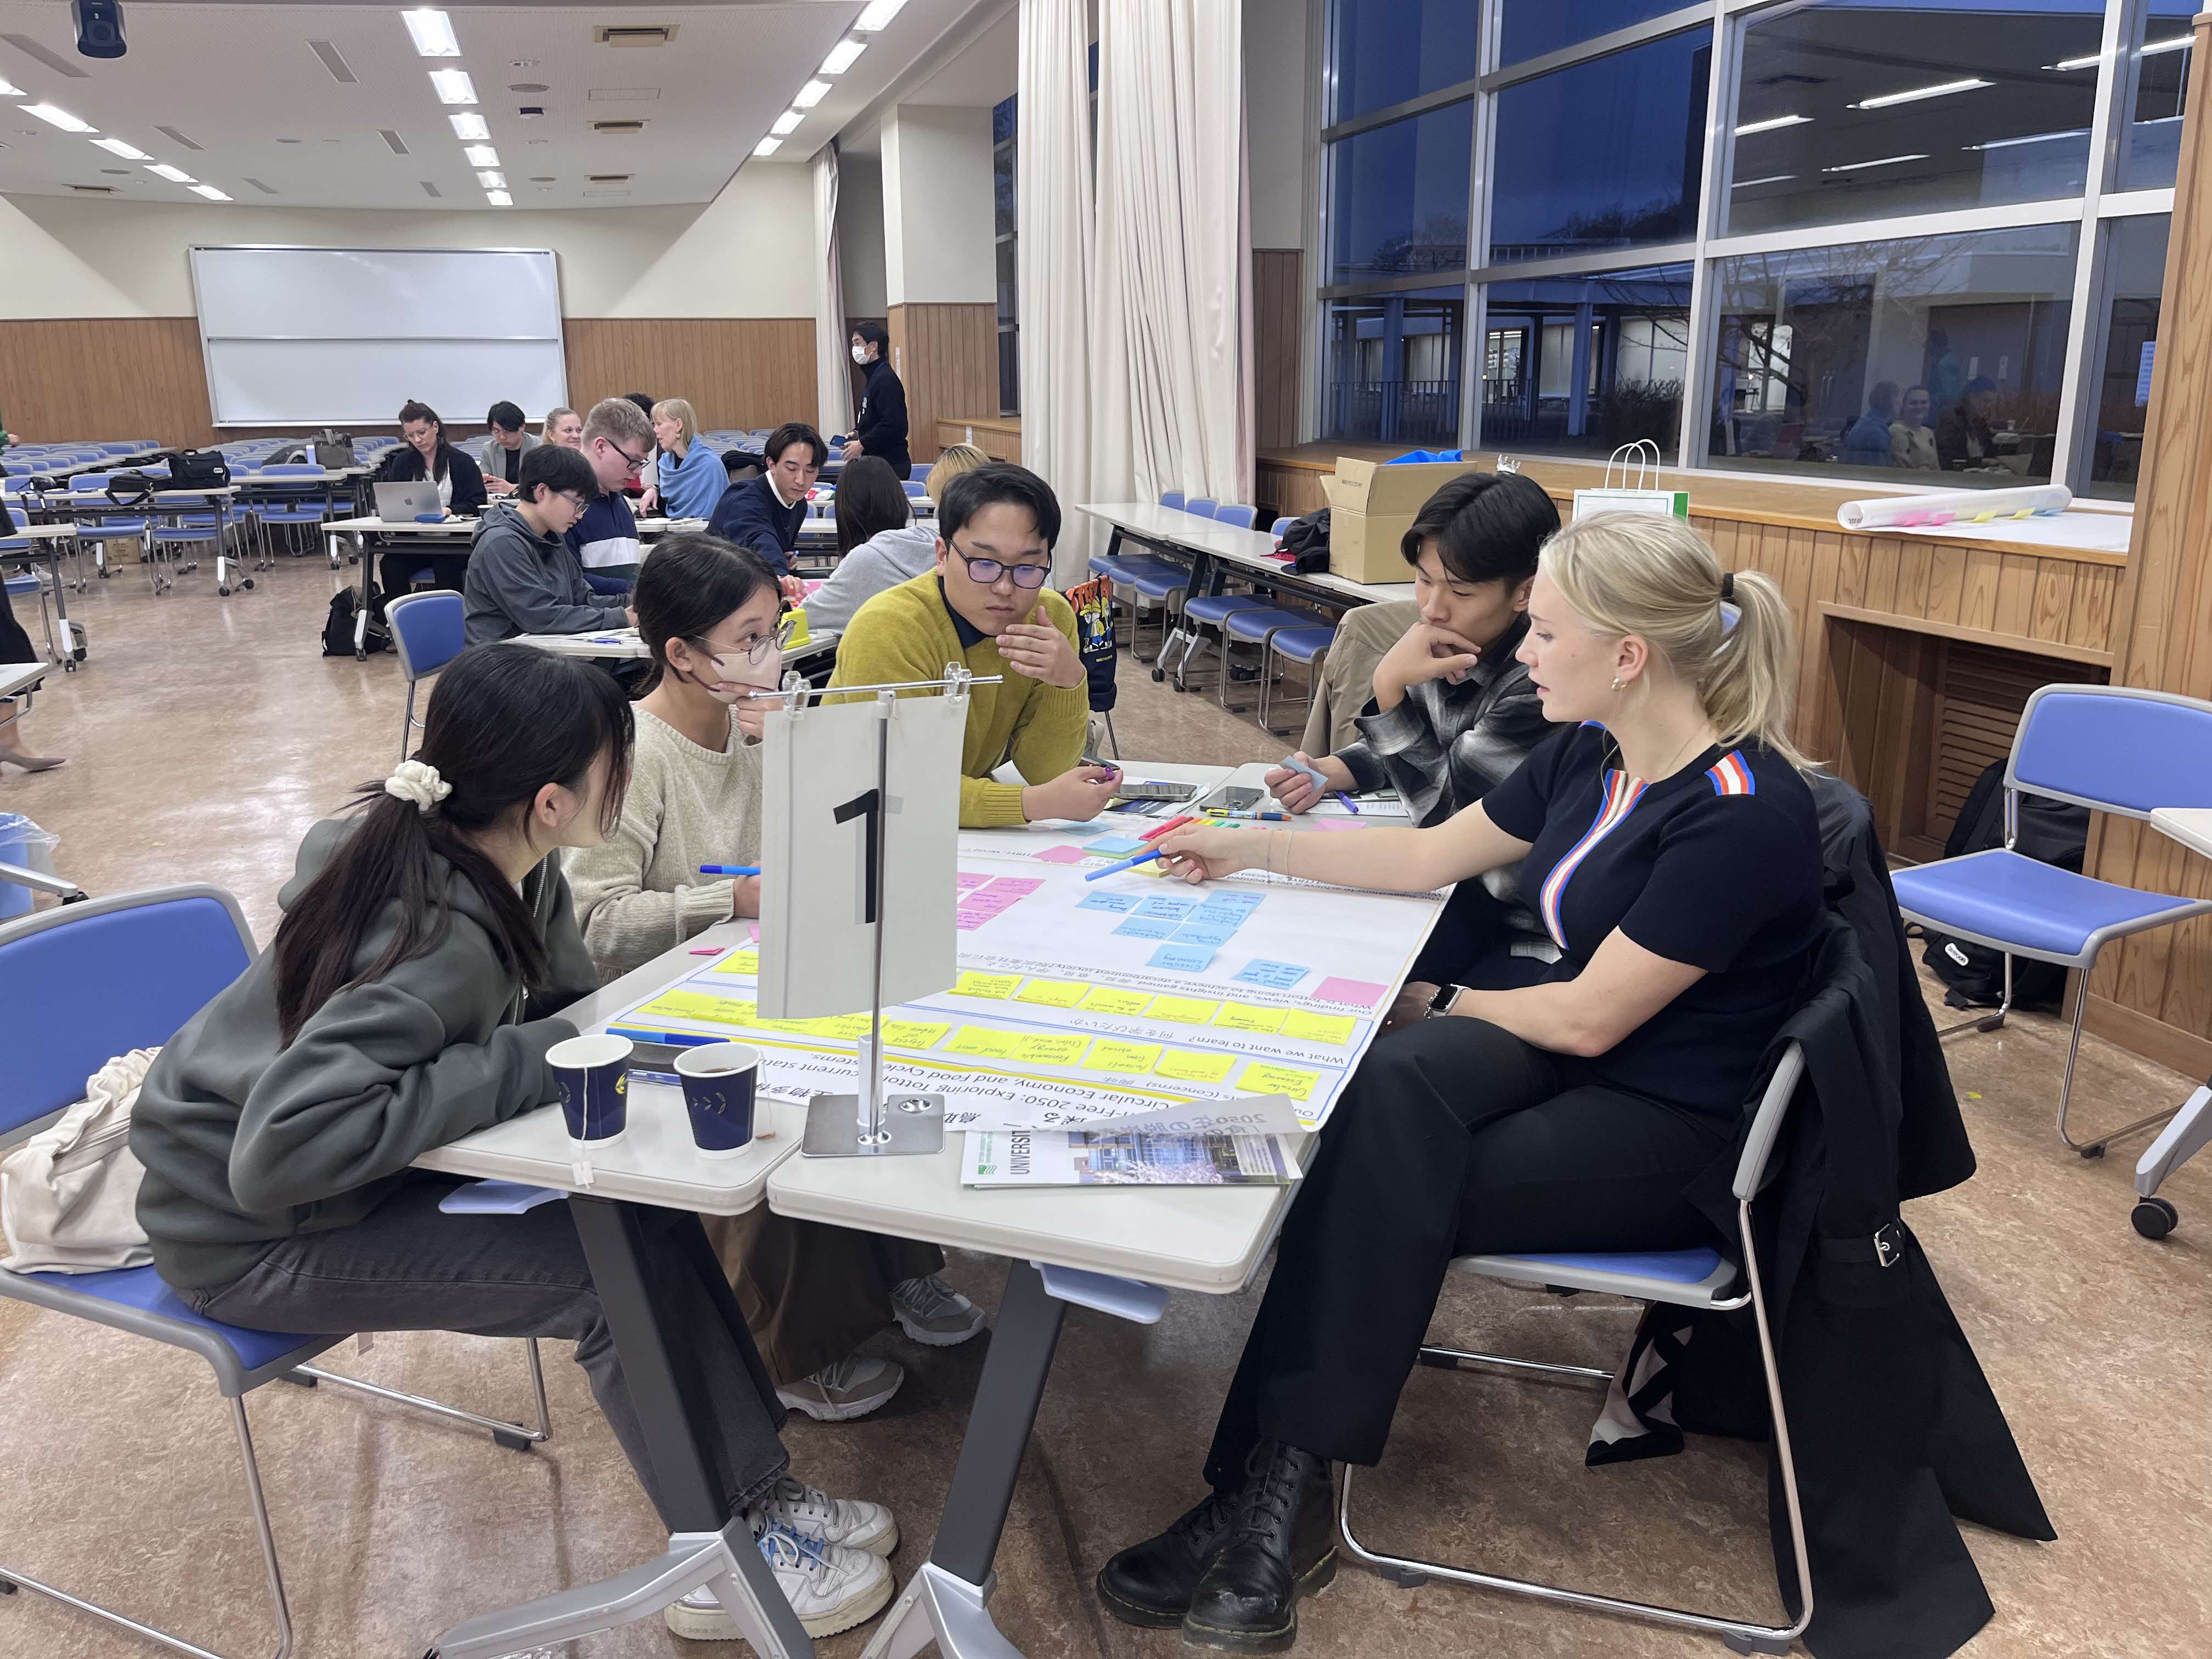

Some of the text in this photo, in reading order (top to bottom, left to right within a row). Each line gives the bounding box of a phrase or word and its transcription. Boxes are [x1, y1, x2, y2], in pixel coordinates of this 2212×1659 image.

[833, 788, 879, 924] 1
[1069, 1019, 1175, 1040] 何を学びたいか
[1188, 1036, 1230, 1048] learn?
[1249, 1043, 1282, 1054] want
[1285, 1050, 1305, 1058] we
[1309, 1053, 1345, 1065] What
[799, 1064, 859, 1076] current
[810, 1054, 1169, 1110] Circular Economy, and Food Cycle stems.
[883, 1076, 930, 1092] Tottor
[1146, 1081, 1219, 1099] (Concerns)
[934, 1085, 1016, 1101] Exploring
[1020, 1094, 1072, 1110] 2050:
[1294, 1109, 1313, 1117] Ou
[1009, 1130, 1030, 1175] UNIVERSIT
